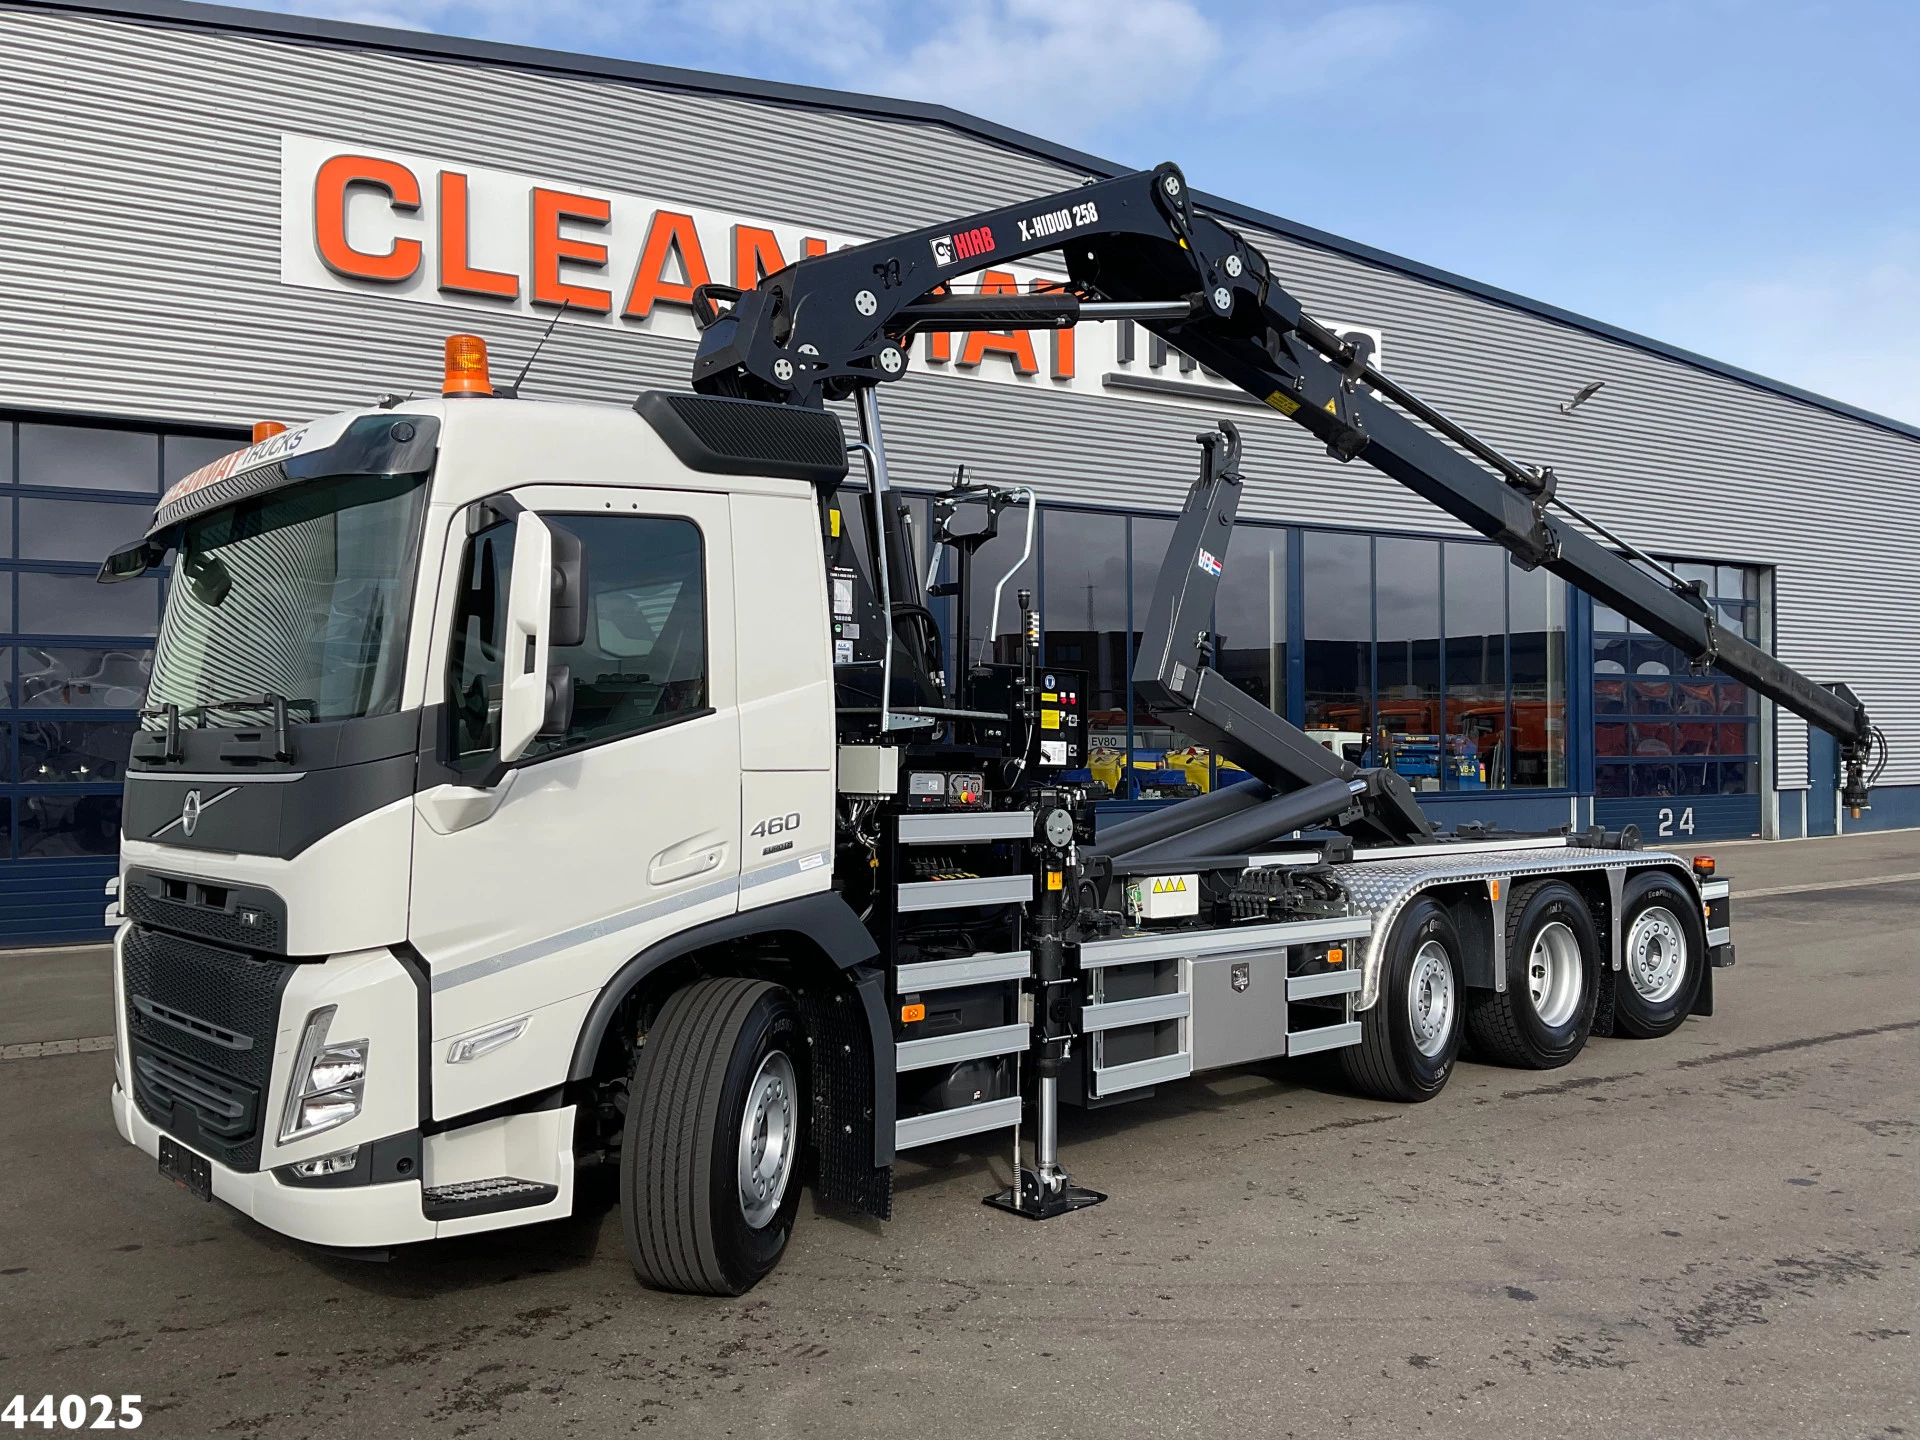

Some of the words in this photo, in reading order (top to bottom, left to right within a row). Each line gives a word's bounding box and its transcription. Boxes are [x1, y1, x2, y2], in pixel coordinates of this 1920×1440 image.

[1017, 209, 1073, 242] X-HIDUO
[1073, 202, 1099, 227] 258
[953, 226, 995, 259] HIAB
[313, 154, 1090, 380] CLEANAT
[161, 447, 249, 506] EANMAT
[242, 428, 309, 466] TRUCKS
[1091, 737, 1117, 747] EV80
[1460, 765, 1476, 773] VB-A
[750, 812, 801, 837] 460
[1658, 807, 1695, 837] 24
